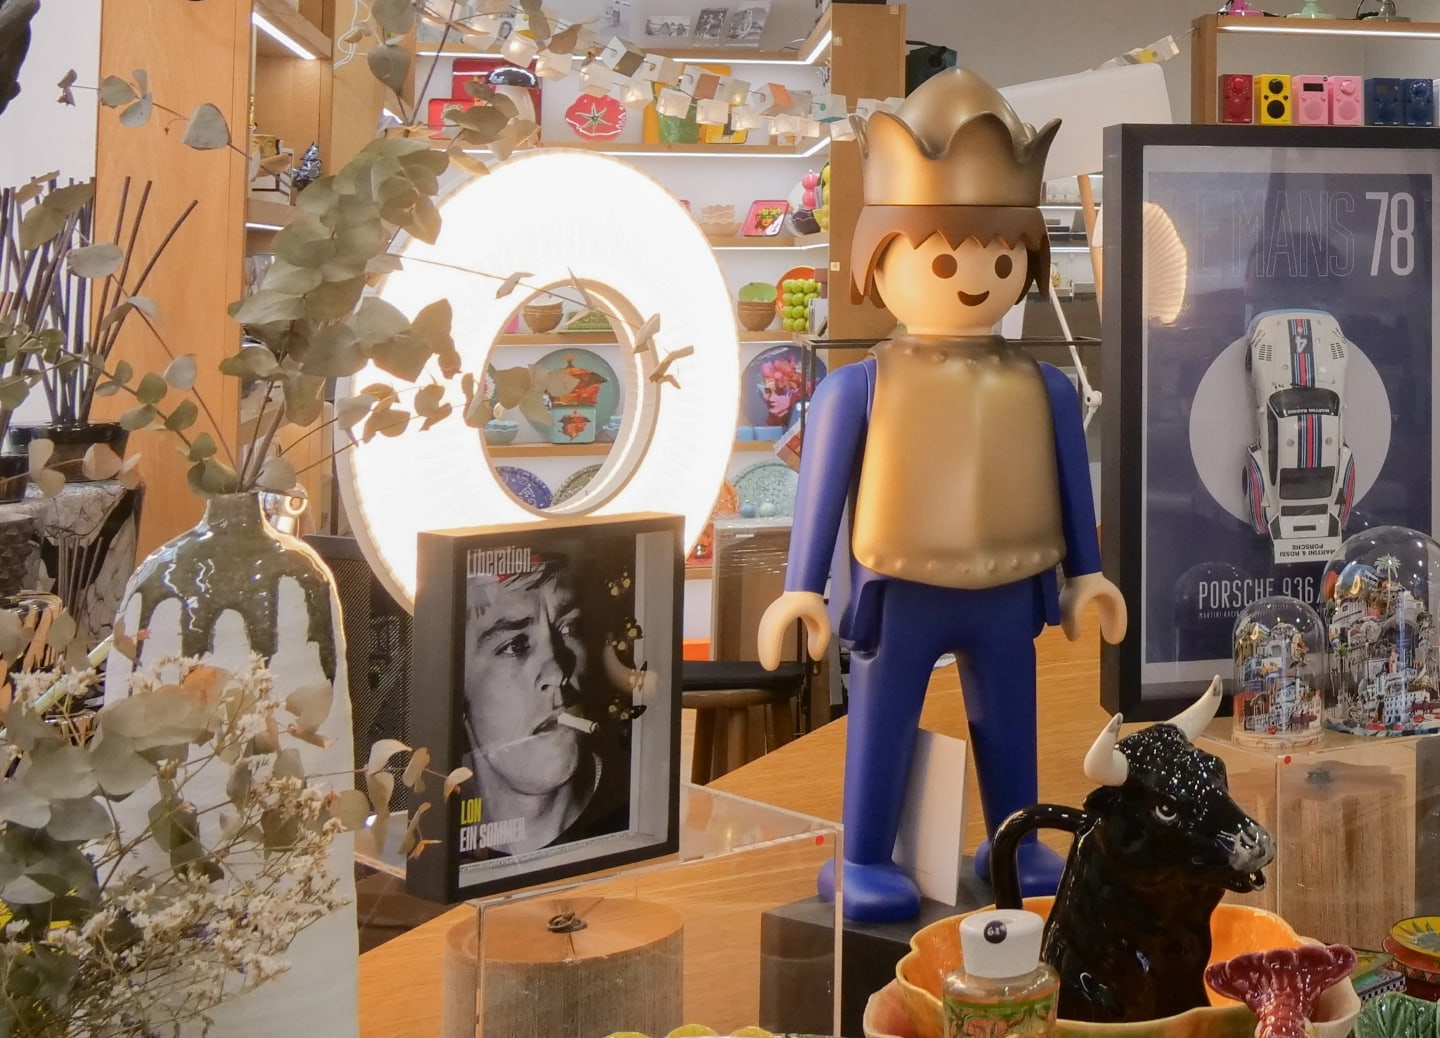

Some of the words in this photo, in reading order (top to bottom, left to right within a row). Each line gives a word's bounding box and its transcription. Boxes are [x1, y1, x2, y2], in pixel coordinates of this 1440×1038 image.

[1231, 190, 1355, 278] MANS
[1365, 191, 1415, 277] 78
[1279, 550, 1299, 558] ROSSI
[1199, 577, 1275, 610] PORSCHE
